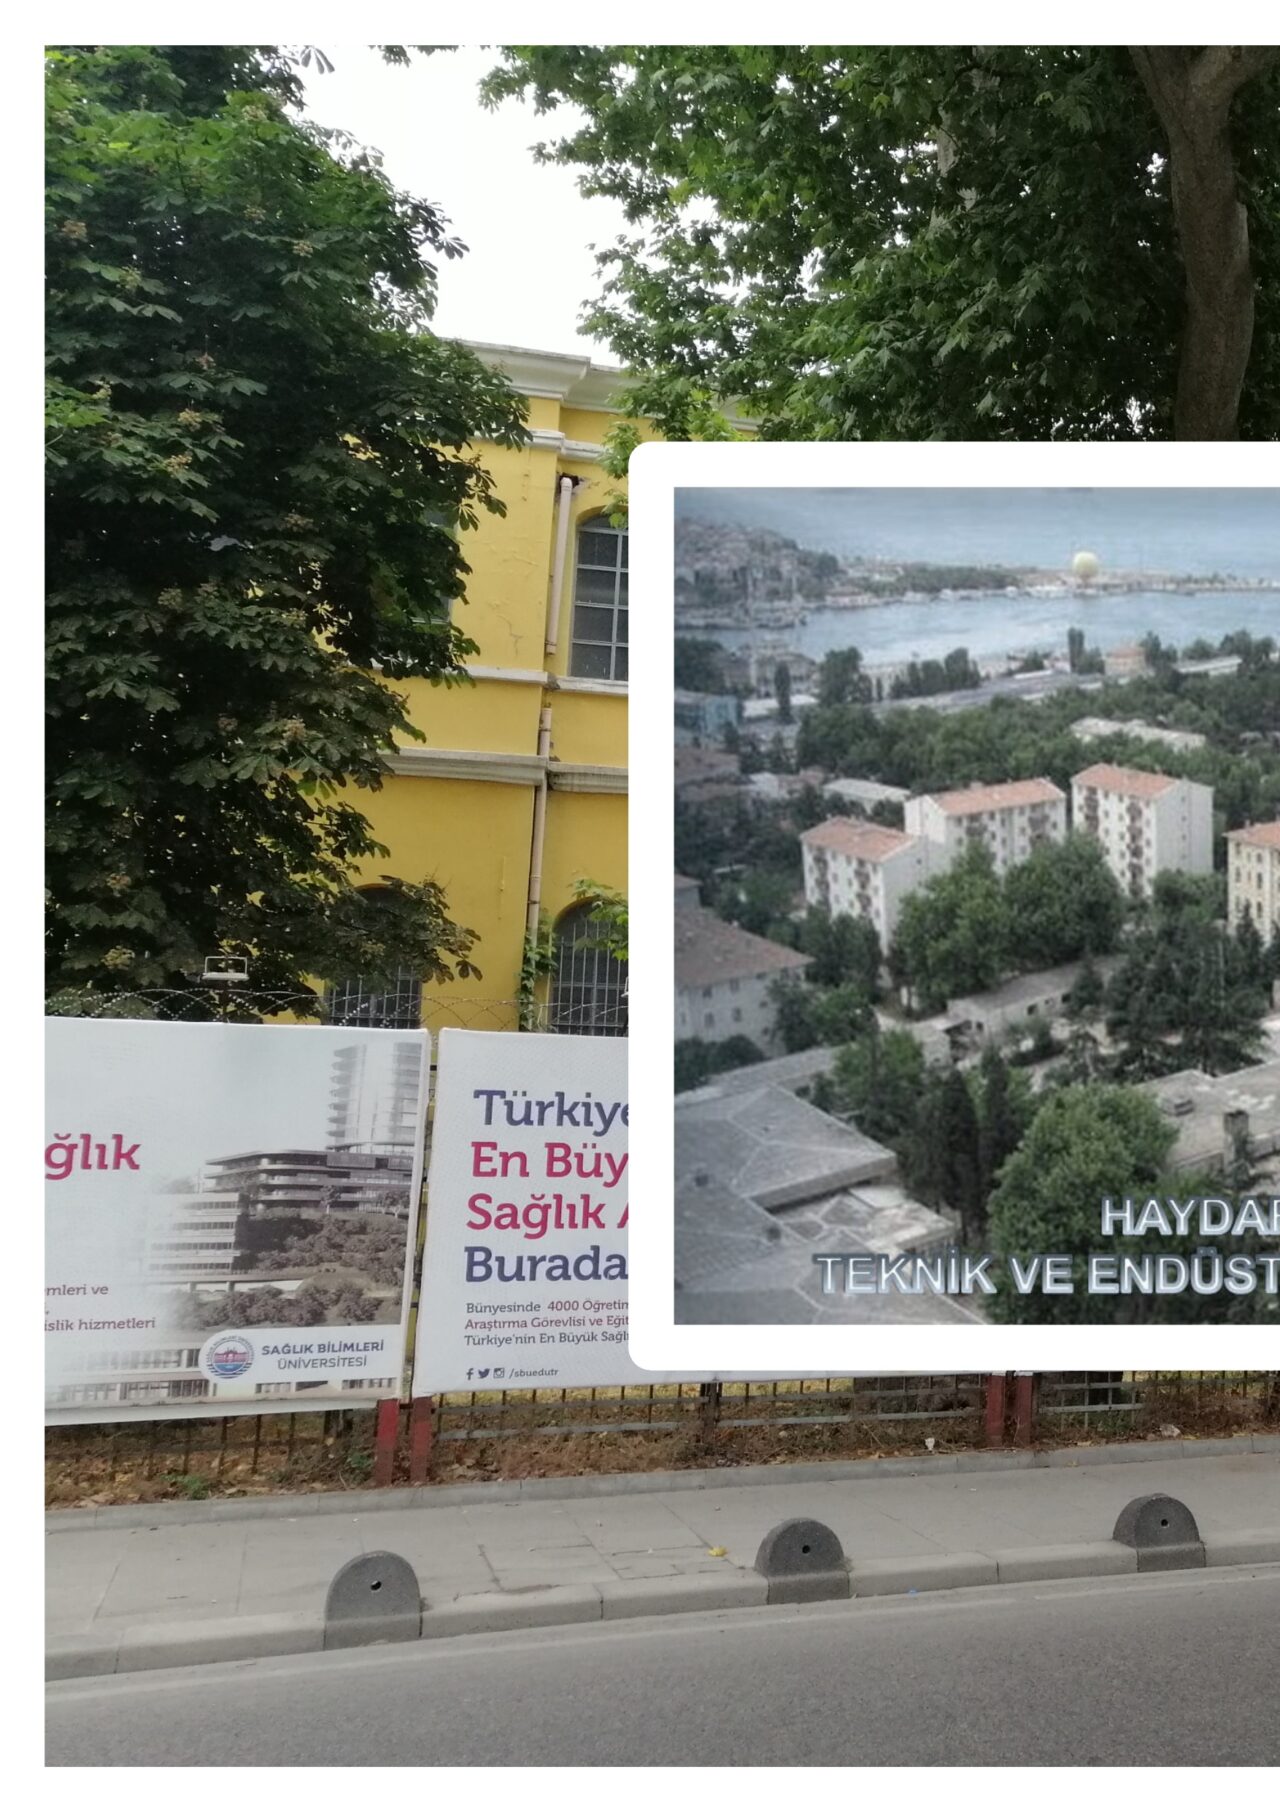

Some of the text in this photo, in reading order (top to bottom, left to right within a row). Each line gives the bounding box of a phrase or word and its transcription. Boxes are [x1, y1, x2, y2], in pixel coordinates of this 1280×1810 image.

[44, 1132, 142, 1181] ğlık
[471, 1141, 529, 1178] En
[466, 1192, 606, 1240] Sağlık
[45, 1284, 109, 1296] mleri ve
[466, 1301, 541, 1317] Bünyesinde
[547, 1300, 579, 1312] 4000
[78, 1317, 156, 1331] hizmetleri
[464, 1318, 527, 1331] Araştırma
[531, 1316, 586, 1328] Görevlisi
[588, 1317, 603, 1326] ve
[464, 1333, 536, 1347] Türkiye'nin
[539, 1333, 556, 1344] En
[558, 1331, 598, 1345] Büyük
[261, 1342, 313, 1356] SAĞLIK
[317, 1339, 385, 1354] BİLİMLERİ
[277, 1356, 367, 1370] ÜNİVERSİTESİ
[508, 1367, 559, 1379] /sbuedutr
